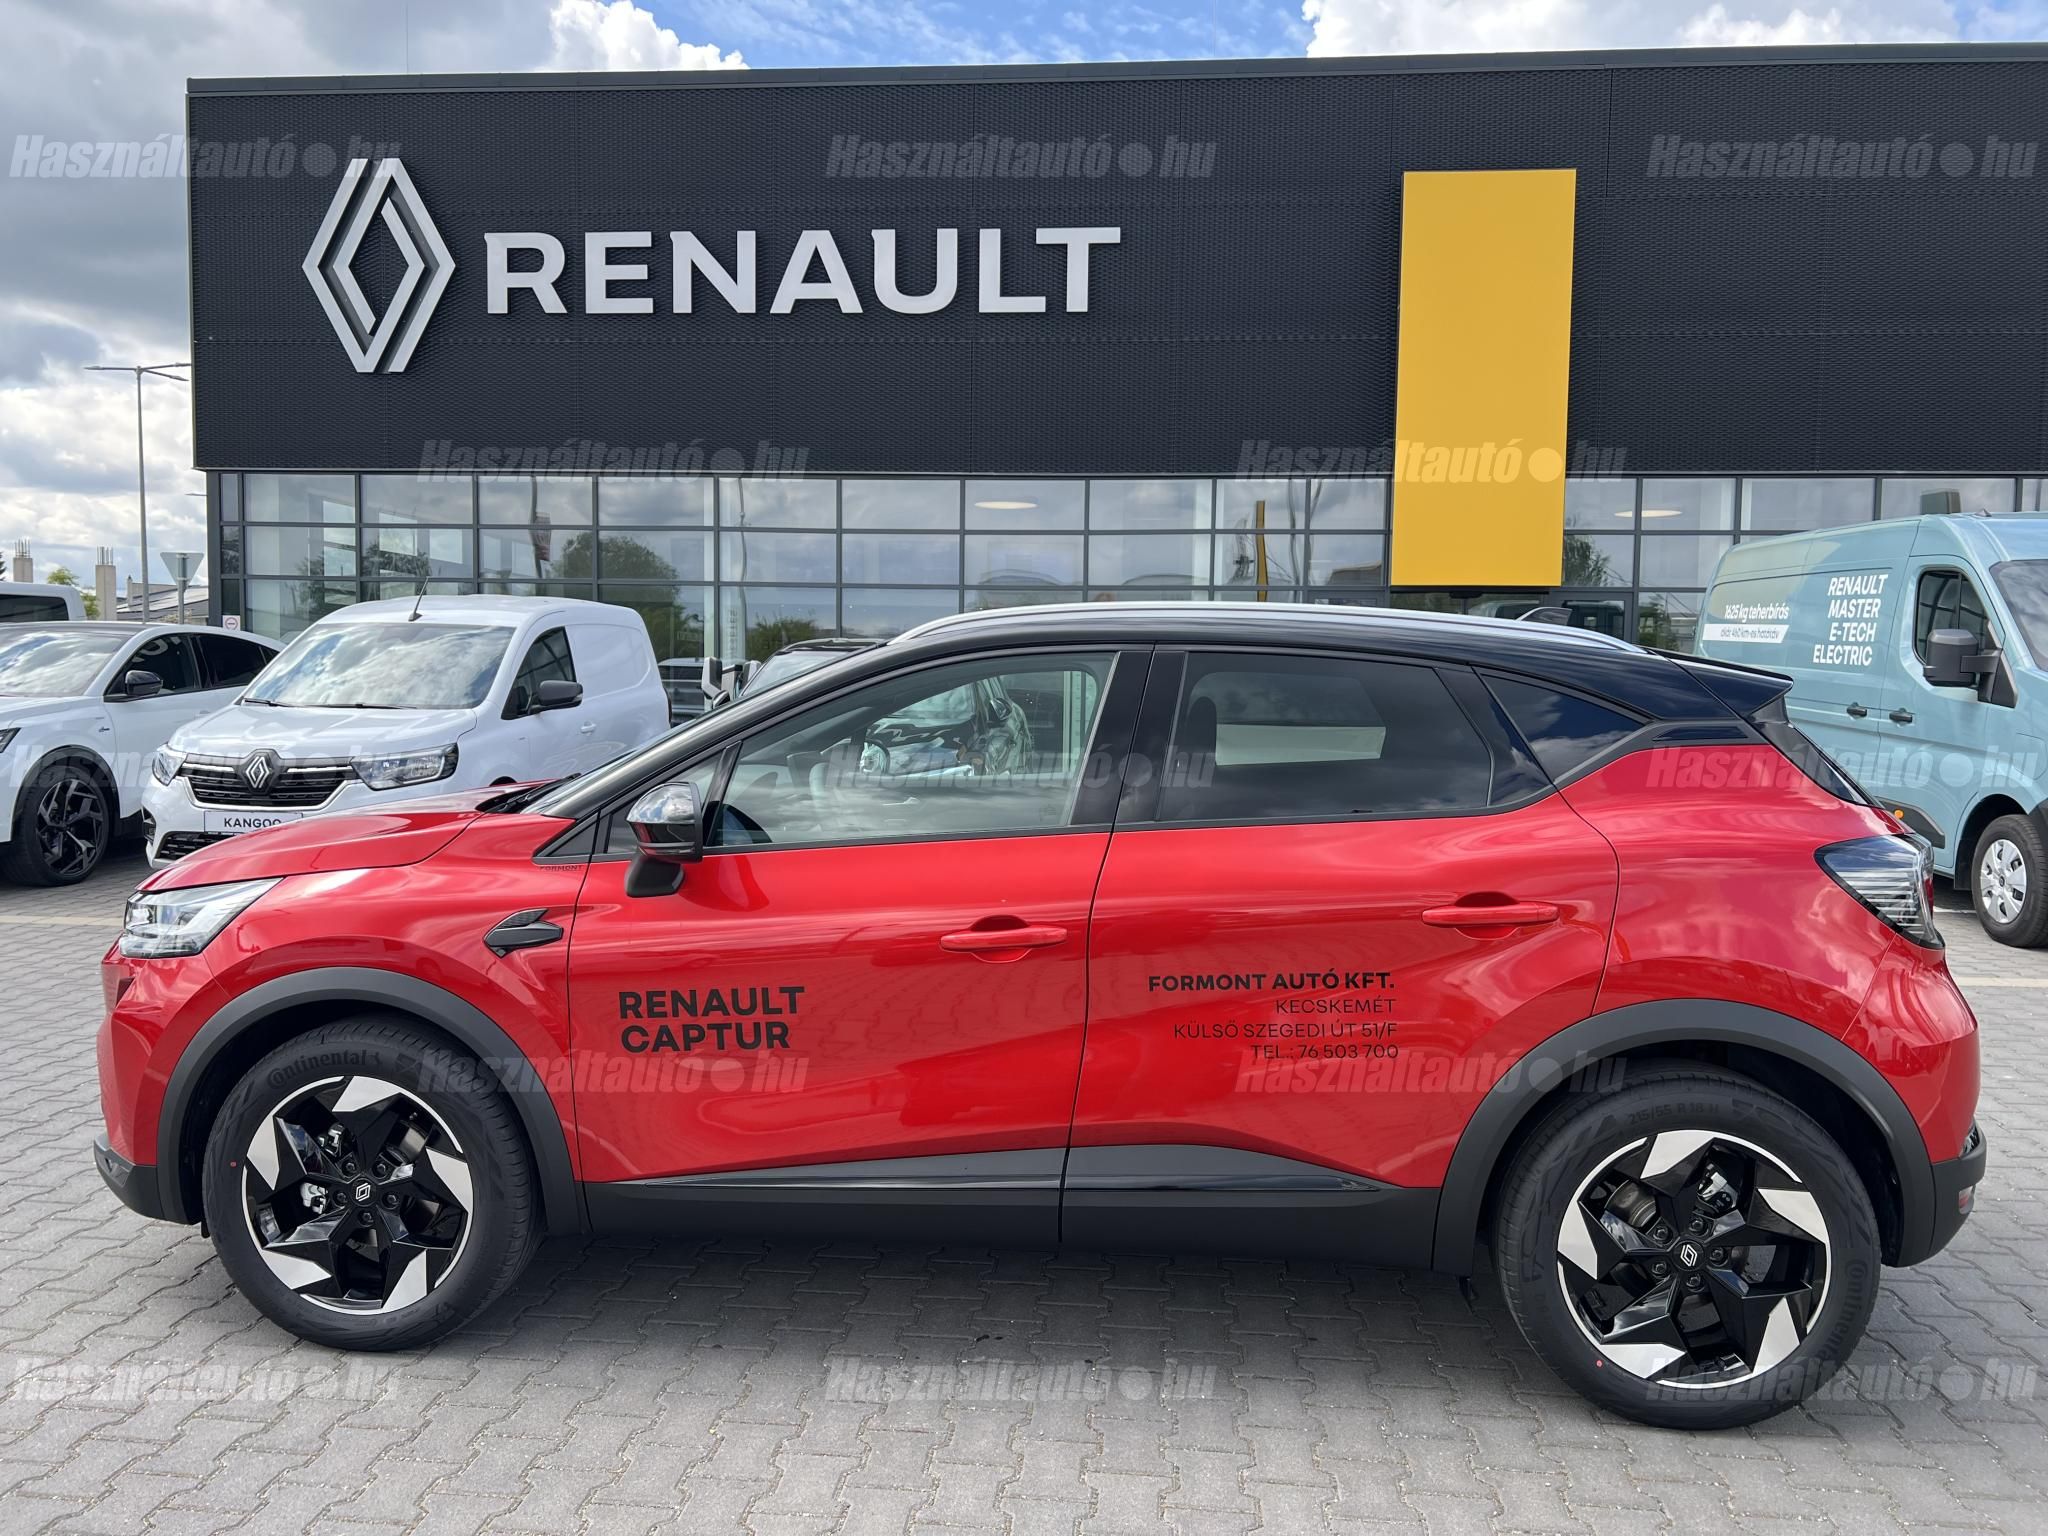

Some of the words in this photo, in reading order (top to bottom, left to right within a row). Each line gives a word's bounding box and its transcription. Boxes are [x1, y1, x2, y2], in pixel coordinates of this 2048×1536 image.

[484, 227, 1121, 315] RENAULT
[1827, 574, 1889, 596] RENAULT
[1739, 603, 1749, 623] kg
[1827, 598, 1882, 618] MASTER
[1829, 622, 1877, 642] E-TECH
[1813, 644, 1873, 666] ELECTRIC
[1148, 973, 1267, 992] FORMONT
[1271, 968, 1340, 990] AUTÓ
[1345, 972, 1395, 990] KFT.
[618, 986, 806, 1019] RENAULT
[1276, 995, 1396, 1014] KECSKEMÉT
[621, 1021, 791, 1054] CAPTUR
[1243, 1023, 1326, 1039] SZEGEDI
[1331, 1018, 1357, 1038] ÚT
[1361, 1021, 1398, 1040] 51/F
[1299, 1044, 1318, 1059] 76
[1323, 1044, 1358, 1059] 503
[1363, 1044, 1399, 1059] 700
